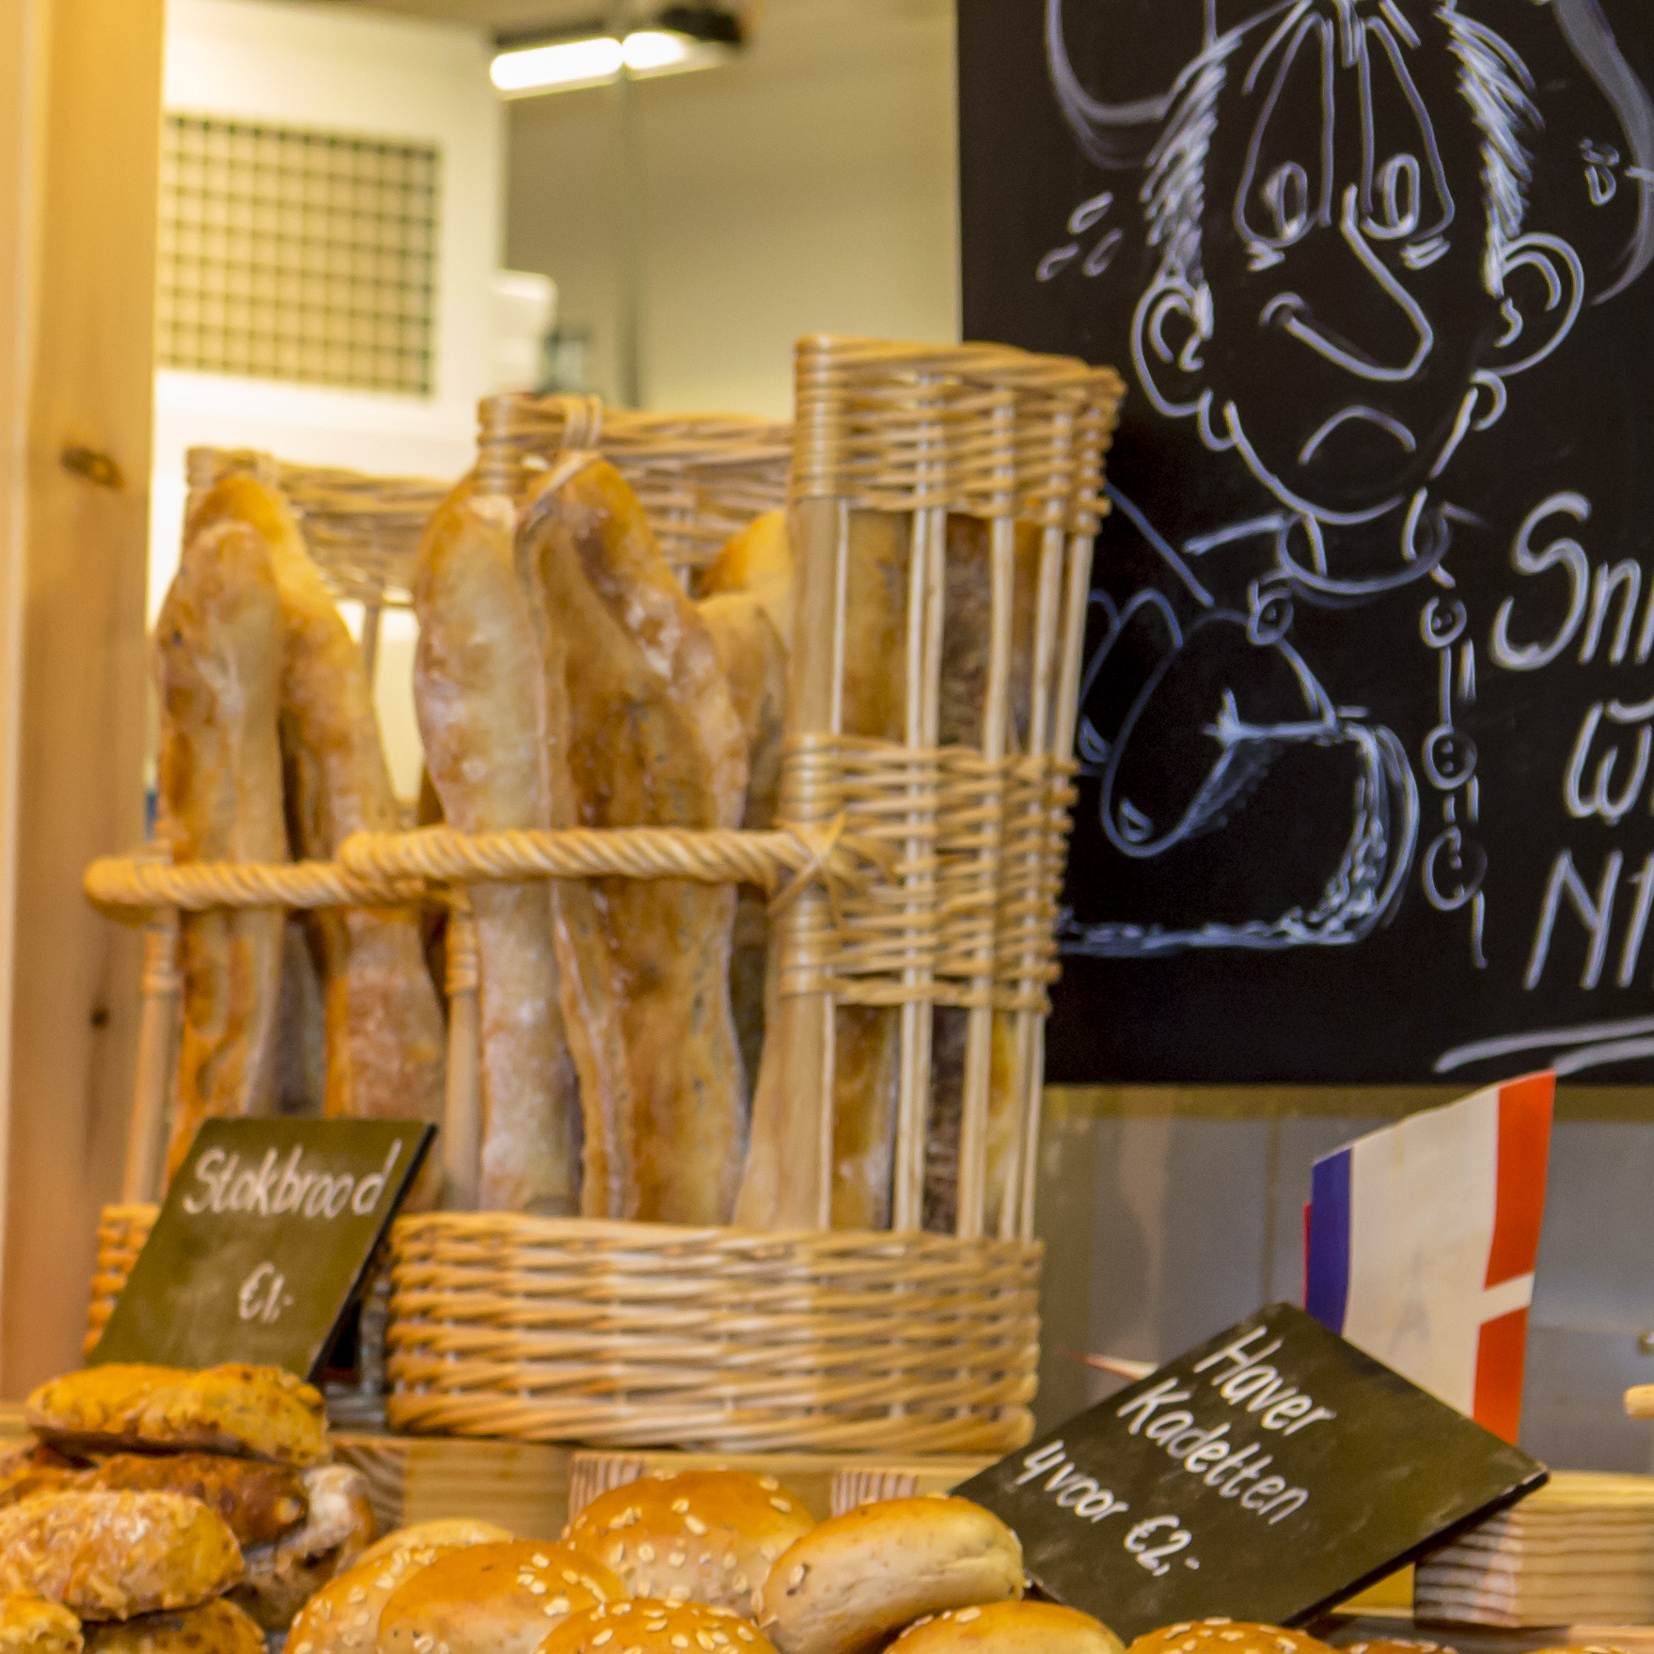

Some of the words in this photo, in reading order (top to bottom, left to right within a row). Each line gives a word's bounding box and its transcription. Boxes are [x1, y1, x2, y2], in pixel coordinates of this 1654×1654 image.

[182, 1138, 404, 1220] Stokbrood
[1195, 1326, 1336, 1436] Haver
[1116, 1377, 1309, 1525] Kadetten
